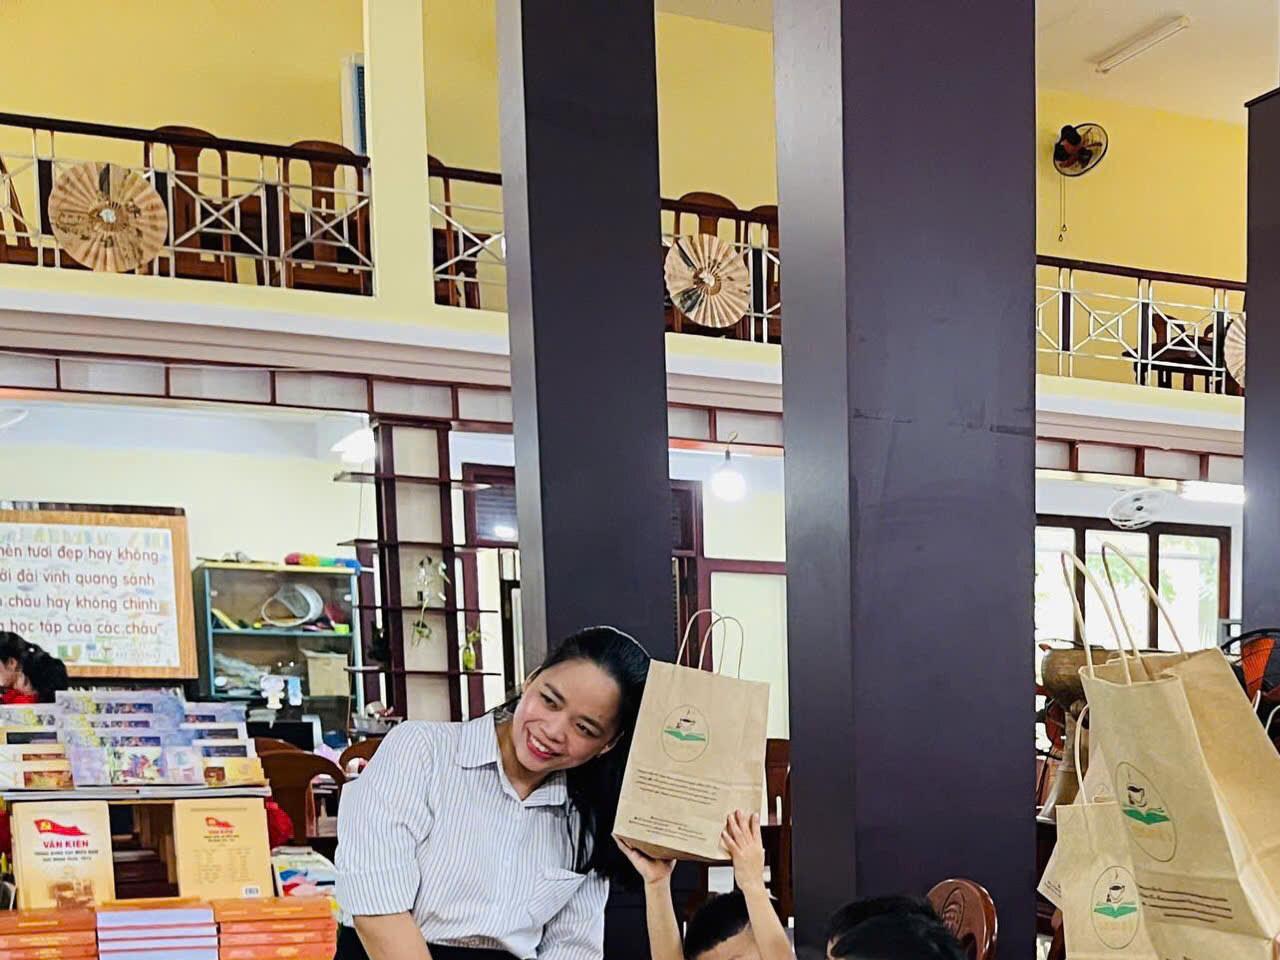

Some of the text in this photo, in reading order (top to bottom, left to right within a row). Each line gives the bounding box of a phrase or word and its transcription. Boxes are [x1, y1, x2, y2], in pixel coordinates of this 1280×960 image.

[57, 545, 83, 563] đẹp
[88, 546, 113, 563] hay
[117, 546, 159, 565] không
[75, 573, 118, 588] quang
[46, 594, 71, 611] hay
[76, 595, 117, 613] không
